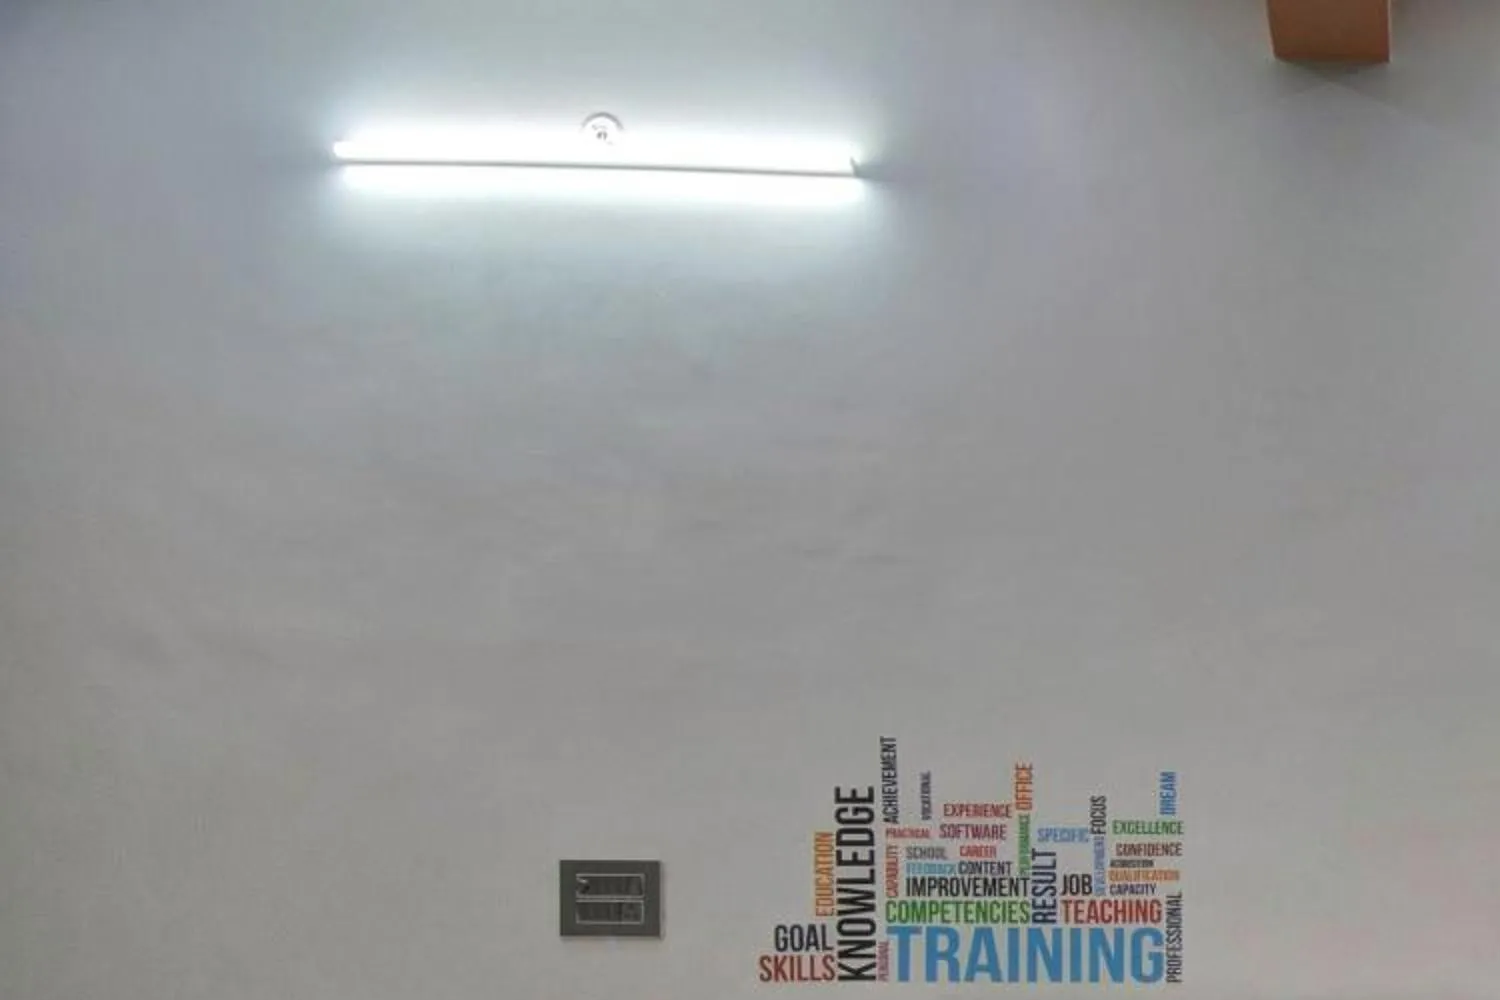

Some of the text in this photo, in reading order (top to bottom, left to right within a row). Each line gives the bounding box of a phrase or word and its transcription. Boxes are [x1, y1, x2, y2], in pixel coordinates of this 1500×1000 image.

[880, 736, 899, 824] ACHIEVEMENT
[1015, 762, 1033, 810] OFFICE
[1159, 771, 1177, 816] DREAM
[943, 803, 1012, 818] EXPERIENCE
[1090, 795, 1106, 835] FOCUS
[939, 823, 1007, 840] SOFTWARE
[1037, 827, 1089, 842] SPECIFIC
[1112, 820, 1184, 835] EXCELLENCE
[906, 846, 948, 860] SCHOOL
[959, 845, 997, 858] CAREER
[1116, 842, 1183, 857] CONFIDENCE
[814, 831, 834, 917] EDUCATION
[885, 845, 899, 898] CAPABILITY
[958, 861, 1012, 876] CONTENT
[834, 786, 877, 982] KNOWLEDGE
[906, 877, 1030, 897] IMPROVEMENT
[1032, 848, 1057, 925] RESULT
[1060, 874, 1092, 896] JOB
[1110, 884, 1156, 896] CAPACITY
[885, 900, 1030, 924] COMPETENCIES
[1061, 900, 1162, 924] TEACHING
[774, 924, 835, 952] GOAL
[1166, 891, 1182, 983] PROFESSIONAL
[886, 926, 1165, 983] TRAINING
[759, 955, 835, 982] SKILLS
